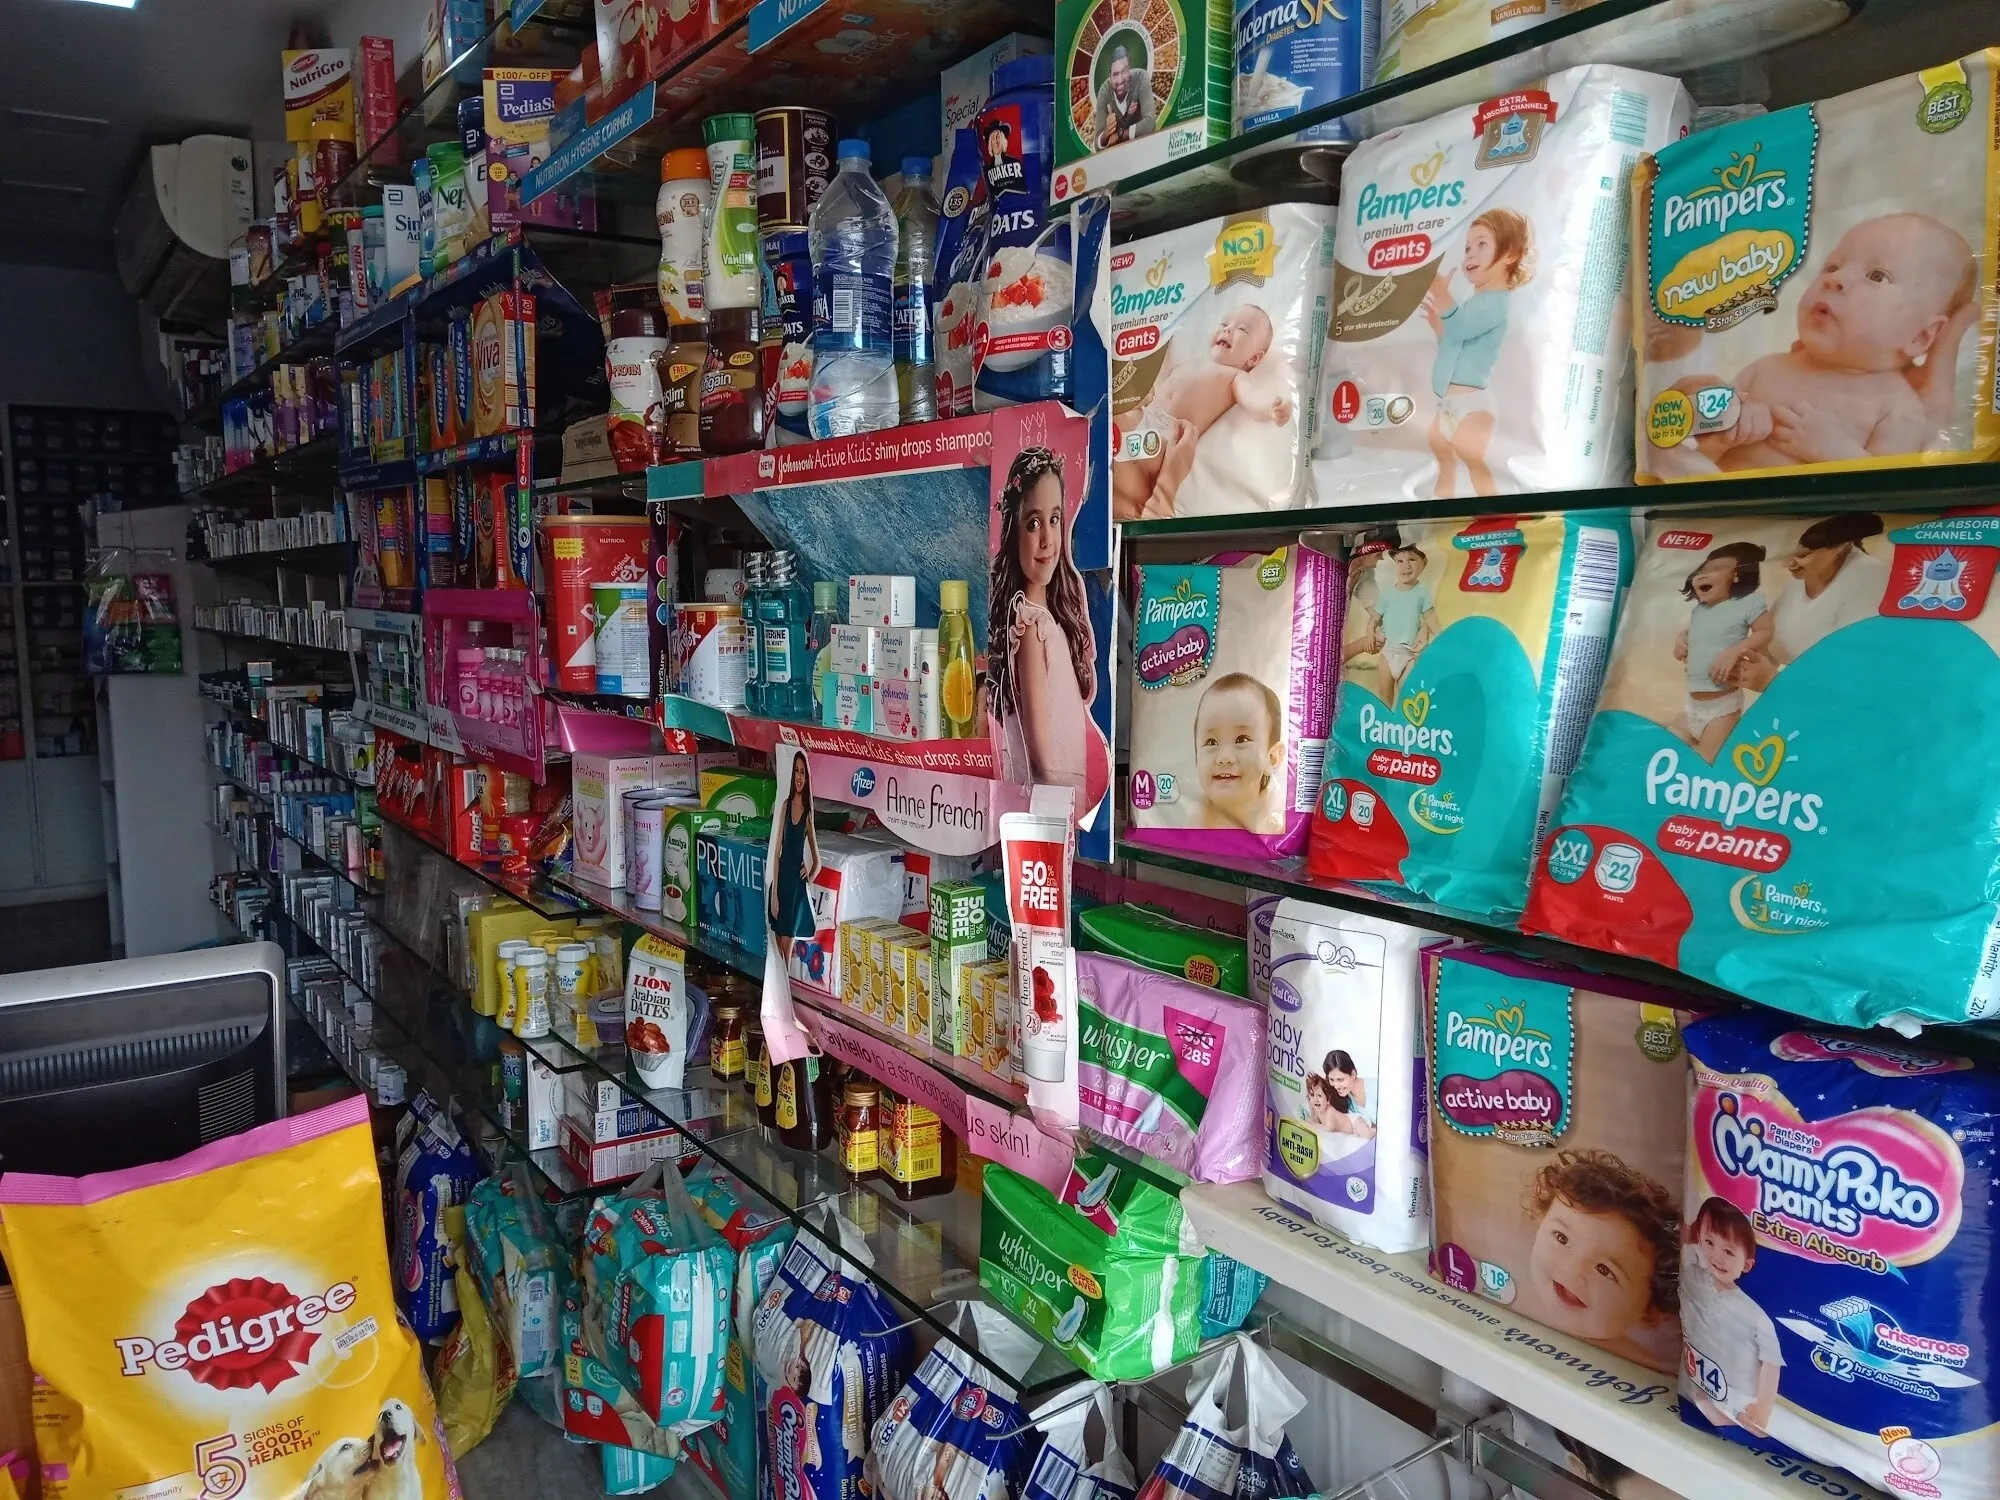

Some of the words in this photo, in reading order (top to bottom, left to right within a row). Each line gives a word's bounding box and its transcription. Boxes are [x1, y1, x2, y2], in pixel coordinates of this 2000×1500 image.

[1495, 8, 1522, 21] VANILLA
[1522, 5, 1541, 14] Toffee
[1266, 25, 1295, 44] DIABETES
[290, 57, 344, 91] NutriGro
[945, 97, 980, 128] Special
[1482, 106, 1509, 121] ABSORB
[1510, 102, 1548, 114] CHANNELS
[1499, 94, 1528, 108] EXTRA
[1927, 97, 1960, 116] BEST
[1254, 113, 1279, 124] VANILLA
[1926, 109, 1961, 124] Pampers
[535, 156, 570, 190] NUTRITION
[569, 131, 600, 168] HYGIENE
[600, 107, 634, 141] CORNER
[1168, 147, 1188, 158] Health
[1189, 143, 1202, 154] Mix
[988, 161, 1023, 181] QUAKER
[1357, 179, 1465, 226] Pampers
[1664, 176, 1786, 238] Pampers
[991, 209, 1036, 238] OATS
[1363, 221, 1415, 244] premium
[1222, 228, 1265, 256] NO.1
[1372, 239, 1426, 264] pants
[352, 244, 367, 299] PROTEIN
[1666, 276, 1717, 308] new
[1720, 240, 1785, 284] baby
[1708, 315, 1717, 331] 5
[1717, 313, 1734, 327] Star
[1735, 306, 1751, 322] Skin
[1752, 298, 1776, 313] Comfort
[1055, 331, 1066, 346] 3
[1119, 330, 1156, 350] pants
[476, 340, 499, 372] Viva
[1341, 385, 1352, 410] L
[1654, 400, 1683, 415] new
[1707, 394, 1729, 413] 24
[1651, 411, 1686, 429] baby
[760, 459, 774, 473] NEW
[778, 449, 814, 484] Johnson's
[814, 445, 847, 468] Active
[874, 442, 900, 468] shiny
[901, 435, 932, 459] drops
[935, 429, 993, 452] shampoo
[1460, 532, 1486, 543] EXTRA
[1487, 530, 1519, 542] ABSORB
[1905, 520, 1943, 530] XTRA
[1946, 519, 2000, 530] ABSORB
[1915, 530, 1983, 541] CHANNELS
[1470, 537, 1509, 548] CHANNELS
[1663, 534, 1704, 547] NEW!
[1262, 568, 1280, 578] BEST
[1145, 597, 1208, 628] Pampers
[1141, 648, 1175, 673] active
[1177, 637, 1205, 658] baby
[1360, 703, 1453, 757] Pampers
[1372, 754, 1391, 765] baby-
[1377, 763, 1389, 774] dry
[1389, 758, 1437, 779] pants
[852, 770, 876, 796] Pfizer
[1136, 775, 1149, 793] M
[1646, 748, 1823, 833] Pampers
[886, 776, 926, 821] Anne
[927, 784, 984, 833] French
[1328, 785, 1345, 810] XL
[1667, 821, 1700, 838] baby-
[1552, 837, 1589, 869] XXL
[1675, 837, 1696, 852] dry
[1697, 828, 1783, 865] pants
[697, 839, 767, 892] PREMIE
[1021, 860, 1047, 886] 50
[1047, 865, 1055, 877] %
[1609, 861, 1631, 882] 22
[1020, 886, 1060, 912] FREE
[1603, 893, 1624, 904] PANTS
[1751, 880, 1762, 899] 1
[1765, 884, 1822, 913] Pampers
[1188, 969, 1214, 985] SAVER
[1190, 959, 1214, 974] SUPER
[632, 987, 671, 1006] Arabian
[633, 975, 672, 993] LION
[631, 998, 670, 1020] DATES
[1284, 994, 1300, 1008] Care
[1081, 1021, 1166, 1073] whisper
[1446, 1011, 1553, 1068] Pampers
[1643, 1043, 1673, 1055] Pampers
[1644, 1031, 1671, 1046] BEST
[841, 1034, 872, 1066] hello
[871, 1052, 884, 1071] to
[887, 1061, 897, 1077] a
[989, 1119, 1030, 1159] skin!
[1731, 1077, 1769, 1093] Quality
[1445, 1088, 1504, 1112] active
[1506, 1088, 1553, 1117] baby
[1281, 1136, 1314, 1159] ANTI-RASH
[1290, 1132, 1303, 1143] WITH
[1770, 1123, 1792, 1138] Pant
[1793, 1131, 1821, 1148] Style
[1764, 1180, 1859, 1233] pants
[1253, 1205, 1303, 1235] baby
[1305, 1223, 1338, 1249] for
[1752, 1217, 1802, 1247] Extra
[1806, 1232, 1887, 1275] Absorb
[1000, 1230, 1071, 1292] whisper
[1340, 1242, 1389, 1276] best
[1449, 1247, 1463, 1276] L
[1071, 1267, 1097, 1288] SUPER
[1072, 1276, 1100, 1298] SAVER
[1391, 1268, 1437, 1298] does
[1490, 1269, 1504, 1288] 18
[1026, 1296, 1038, 1314] XL
[1437, 1286, 1501, 1326] always
[114, 1281, 357, 1377] Pedigree
[1875, 1324, 1968, 1358] Crisscross
[1879, 1339, 1931, 1361] Absorbent
[1932, 1352, 1965, 1367] Sheet
[1500, 1326, 1671, 1406] Johnson's
[1696, 1358, 1722, 1390] 14
[1829, 1352, 1854, 1379] 12
[1854, 1363, 1874, 1377] hrs
[1875, 1371, 1930, 1397] Absorption
[244, 1423, 285, 1444] SIGNS
[287, 1416, 305, 1430] OF
[1881, 1427, 1909, 1442] New
[248, 1437, 314, 1469] HEALTH
[194, 1434, 248, 1500] 5
